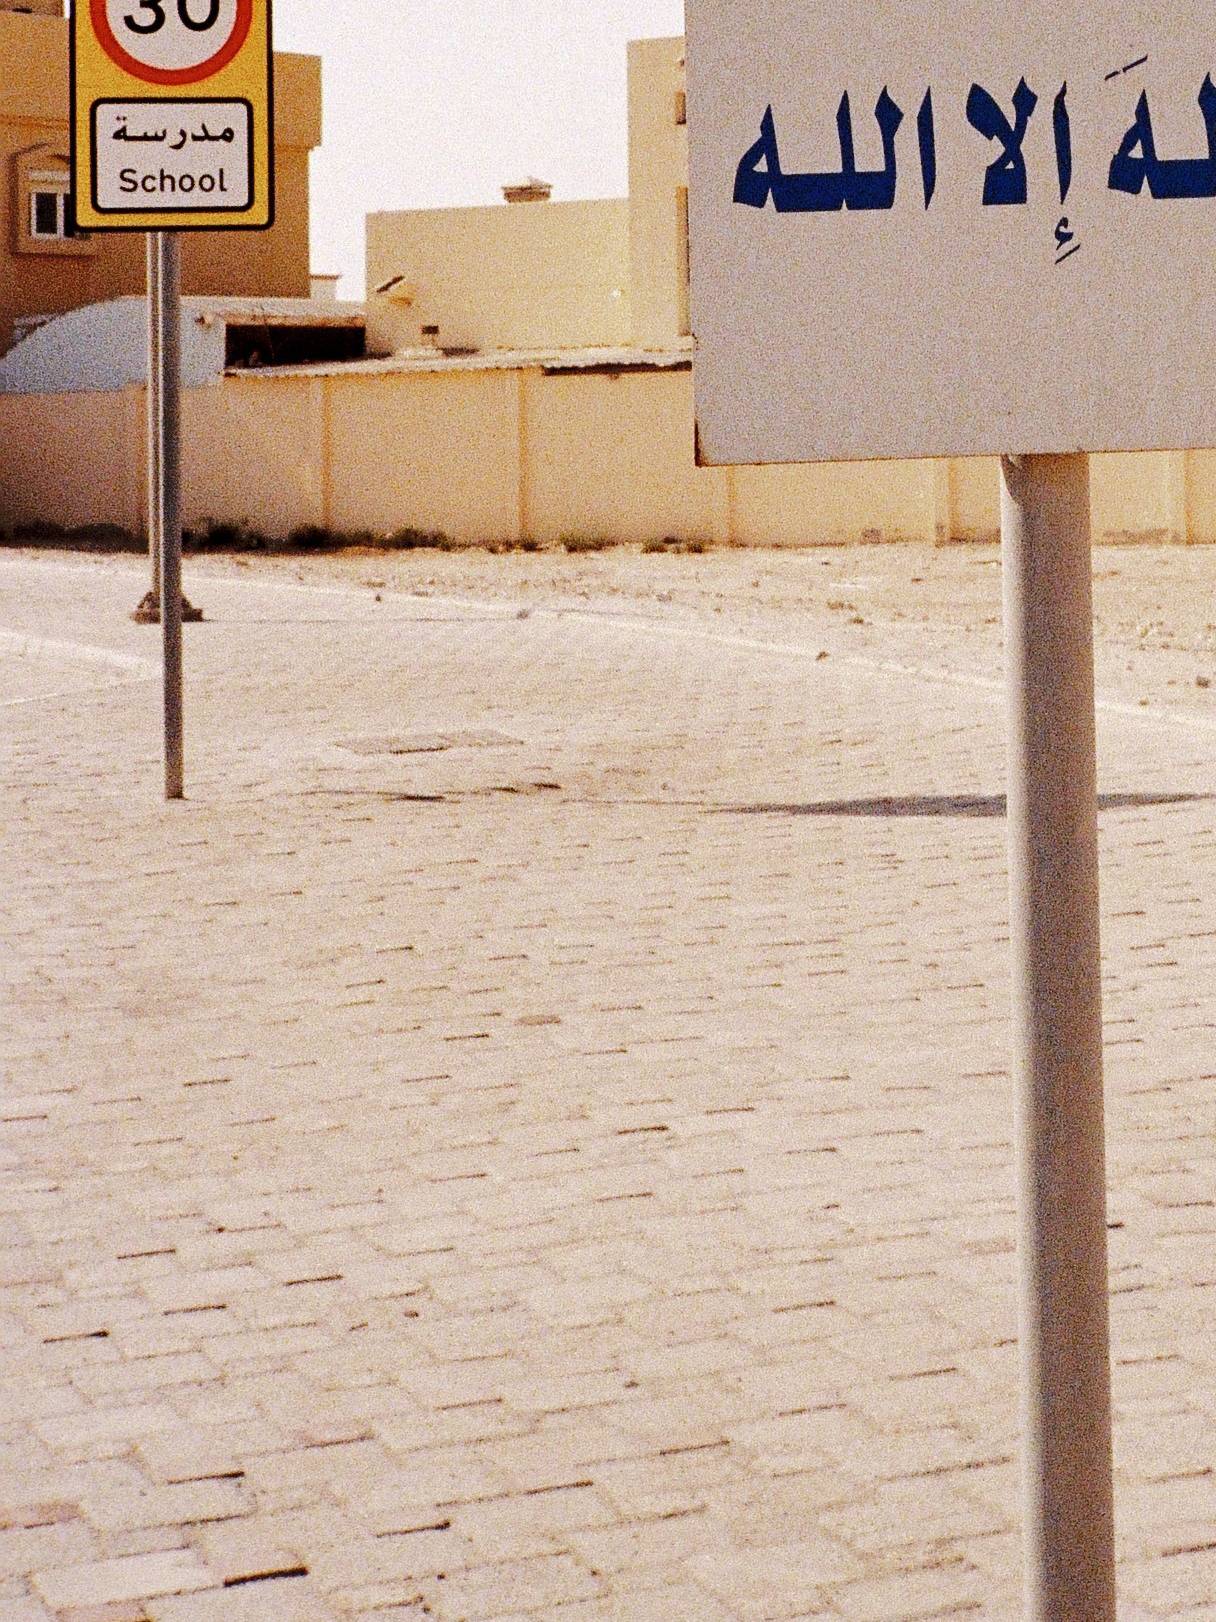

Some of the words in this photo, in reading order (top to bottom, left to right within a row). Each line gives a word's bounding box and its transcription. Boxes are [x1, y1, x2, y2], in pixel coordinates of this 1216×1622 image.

[111, 115, 235, 151] مدرسة
[732, 85, 937, 214] الله
[118, 167, 228, 194] School
